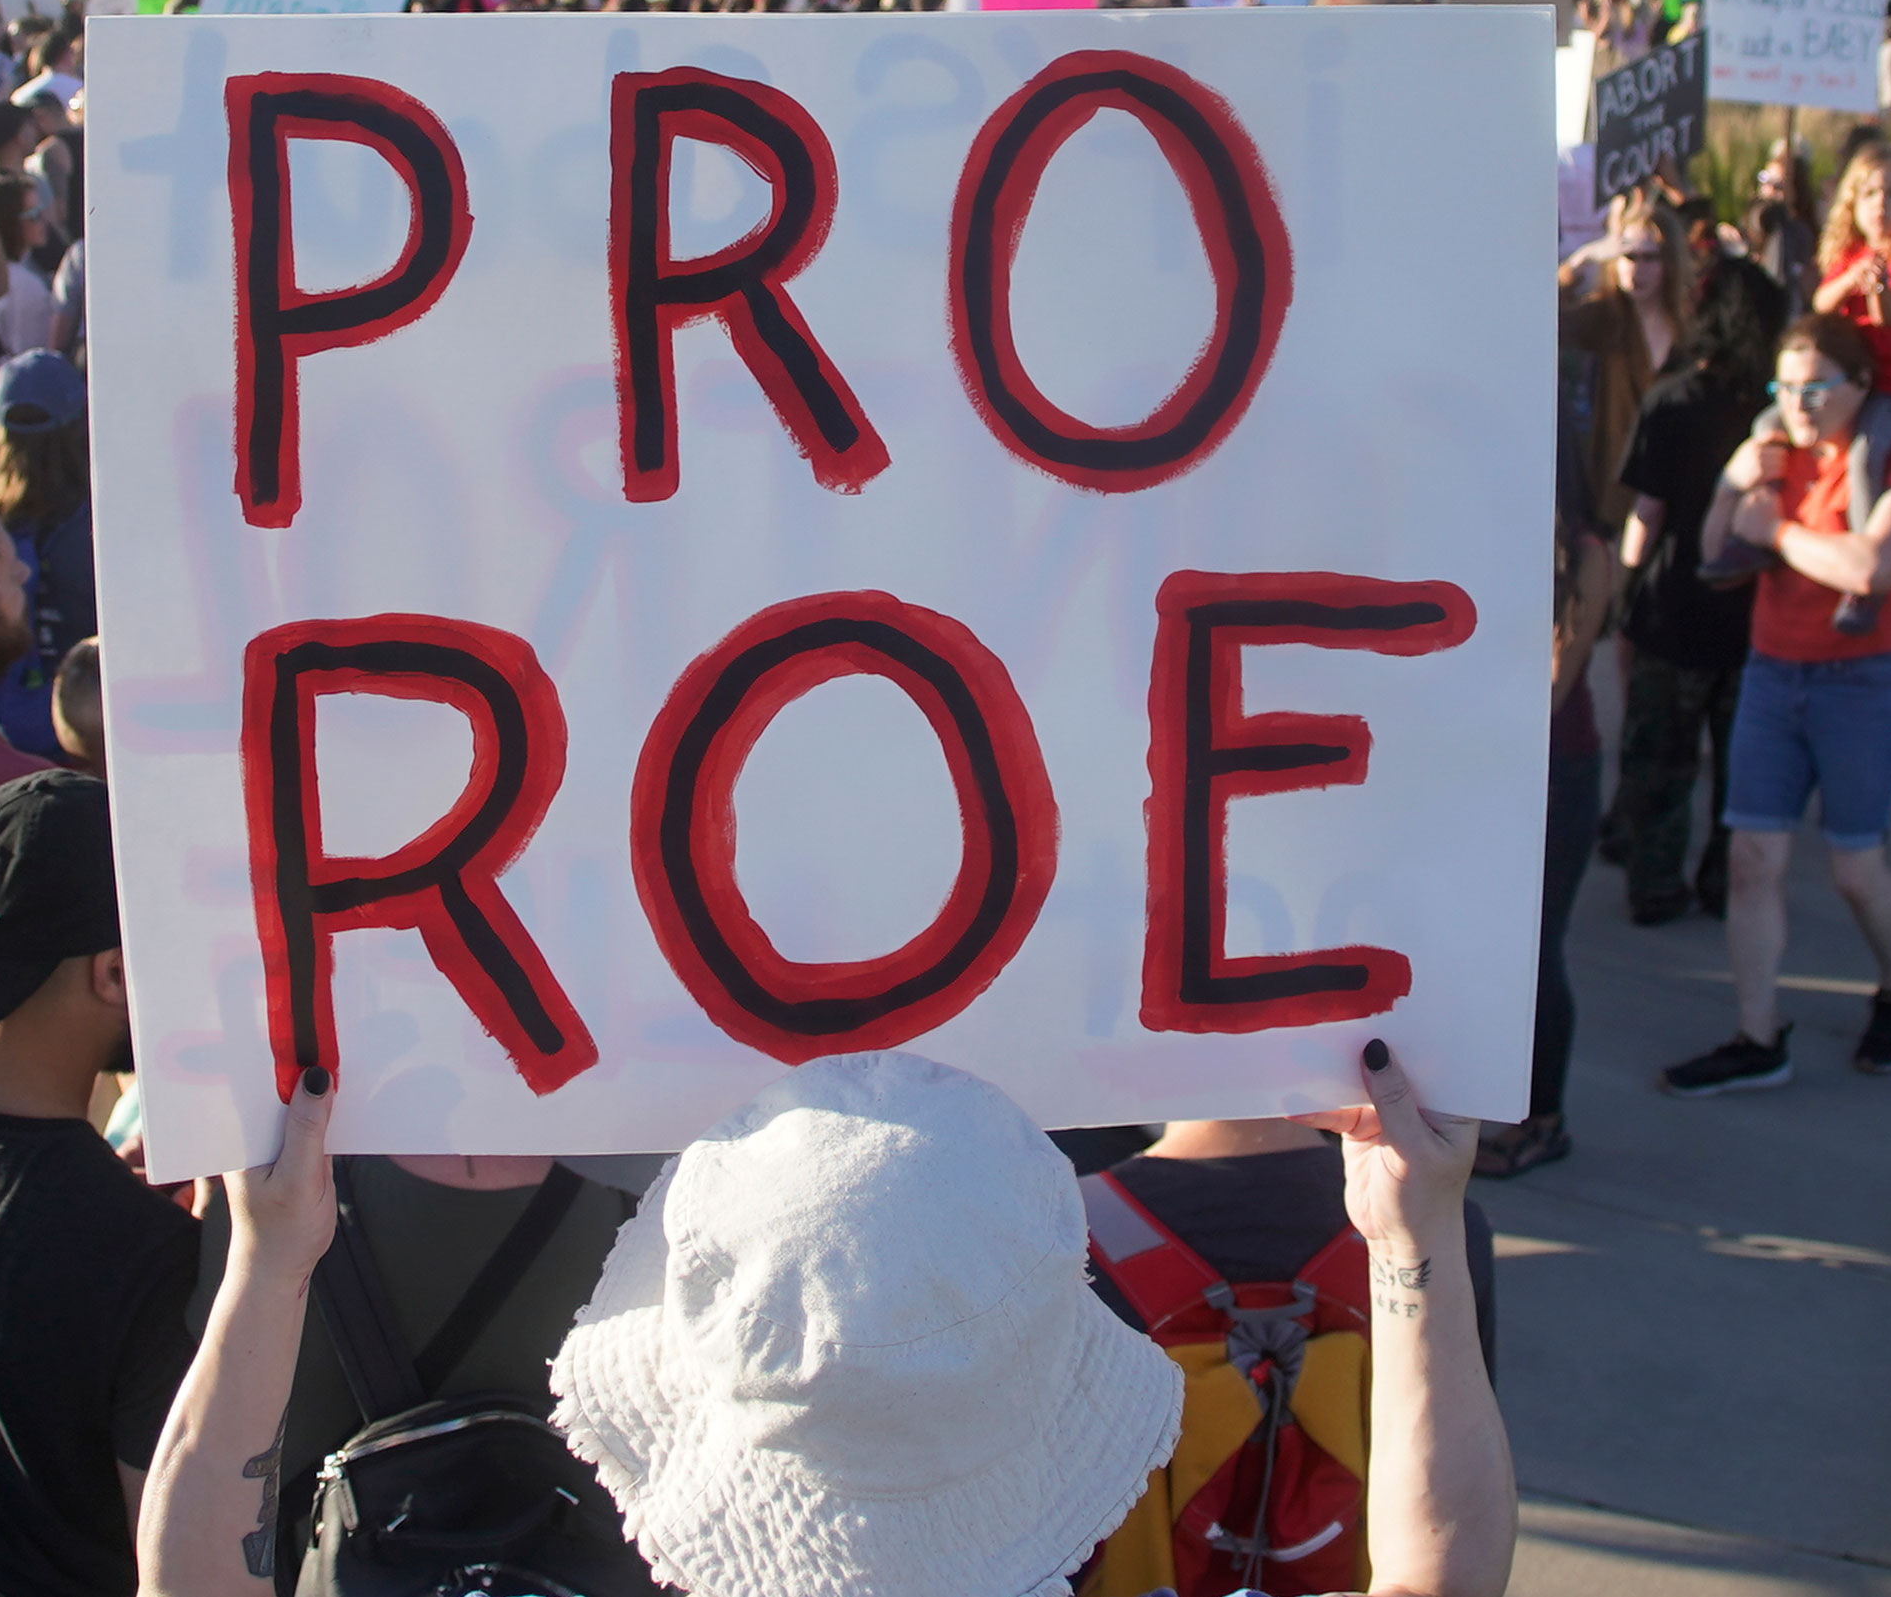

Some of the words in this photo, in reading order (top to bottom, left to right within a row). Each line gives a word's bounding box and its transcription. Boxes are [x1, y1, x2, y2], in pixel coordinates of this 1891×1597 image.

[1598, 37, 1699, 130] ABORT
[1802, 18, 1876, 62] BABY
[1601, 114, 1695, 197] COURT
[1632, 104, 1665, 133] THE
[225, 49, 1295, 528] PRO
[241, 569, 1477, 1102] ROE
